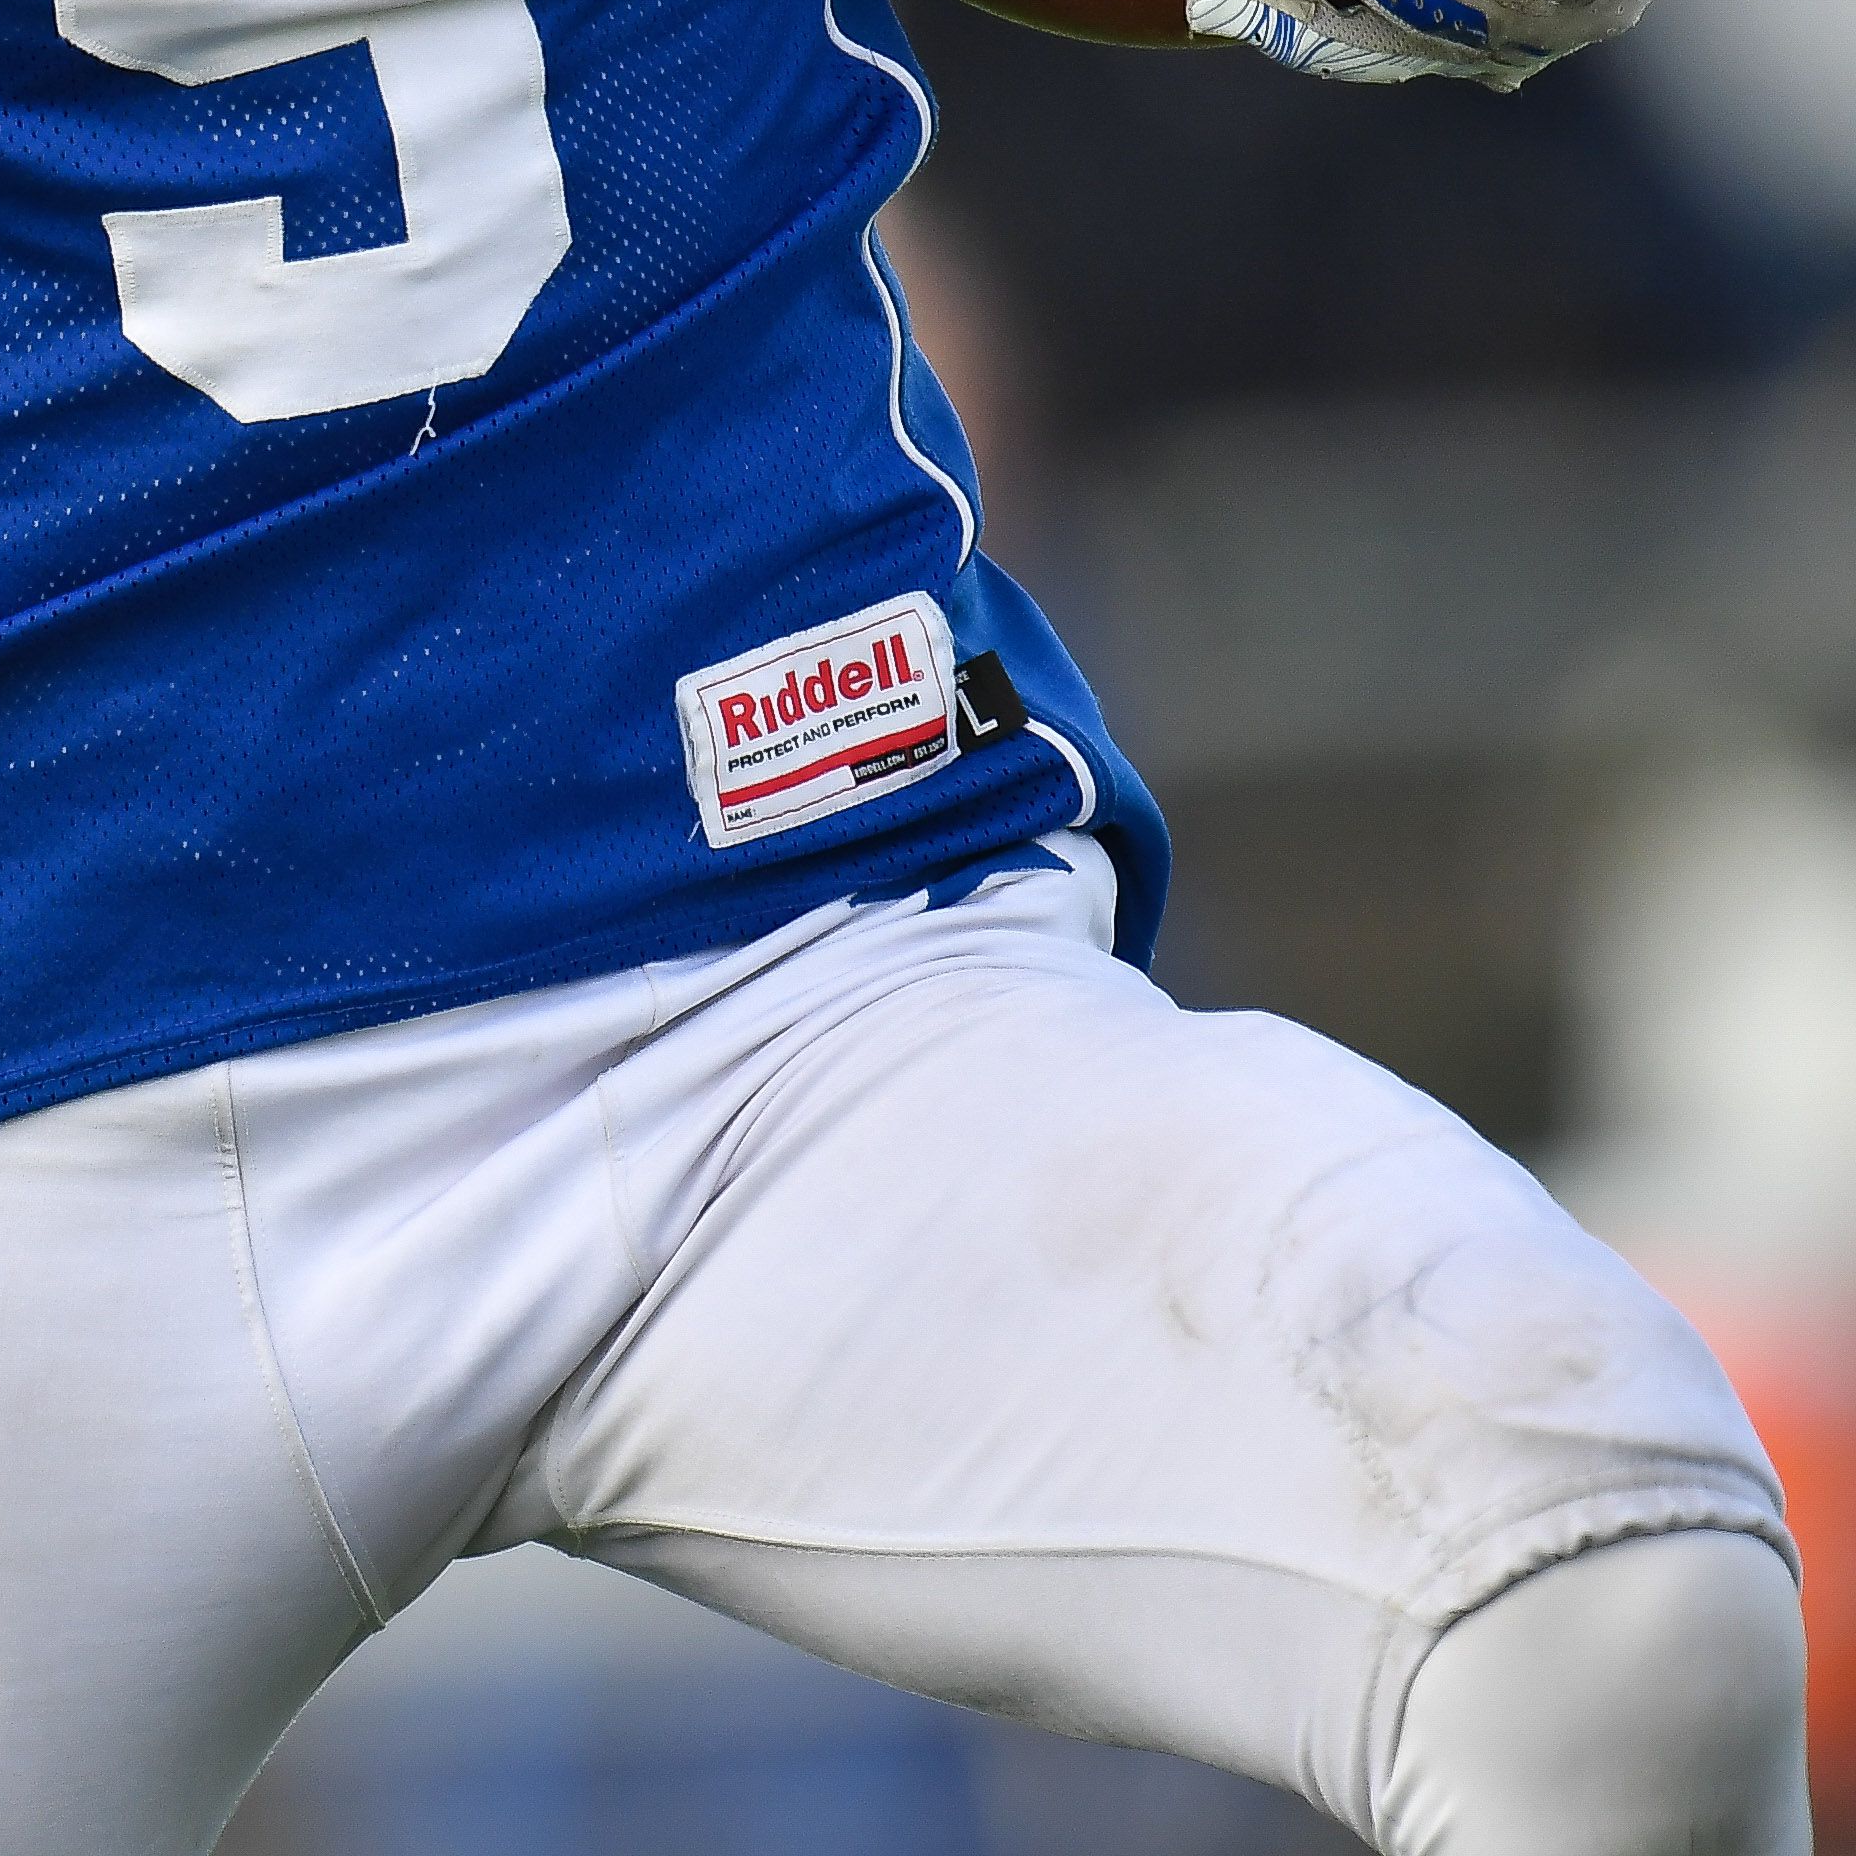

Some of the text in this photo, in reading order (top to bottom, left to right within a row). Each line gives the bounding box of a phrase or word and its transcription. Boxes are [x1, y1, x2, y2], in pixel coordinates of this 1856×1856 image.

[718, 633, 915, 749] Riddell
[955, 688, 999, 736] L
[727, 692, 921, 773] PROTECT AND PERFORM
